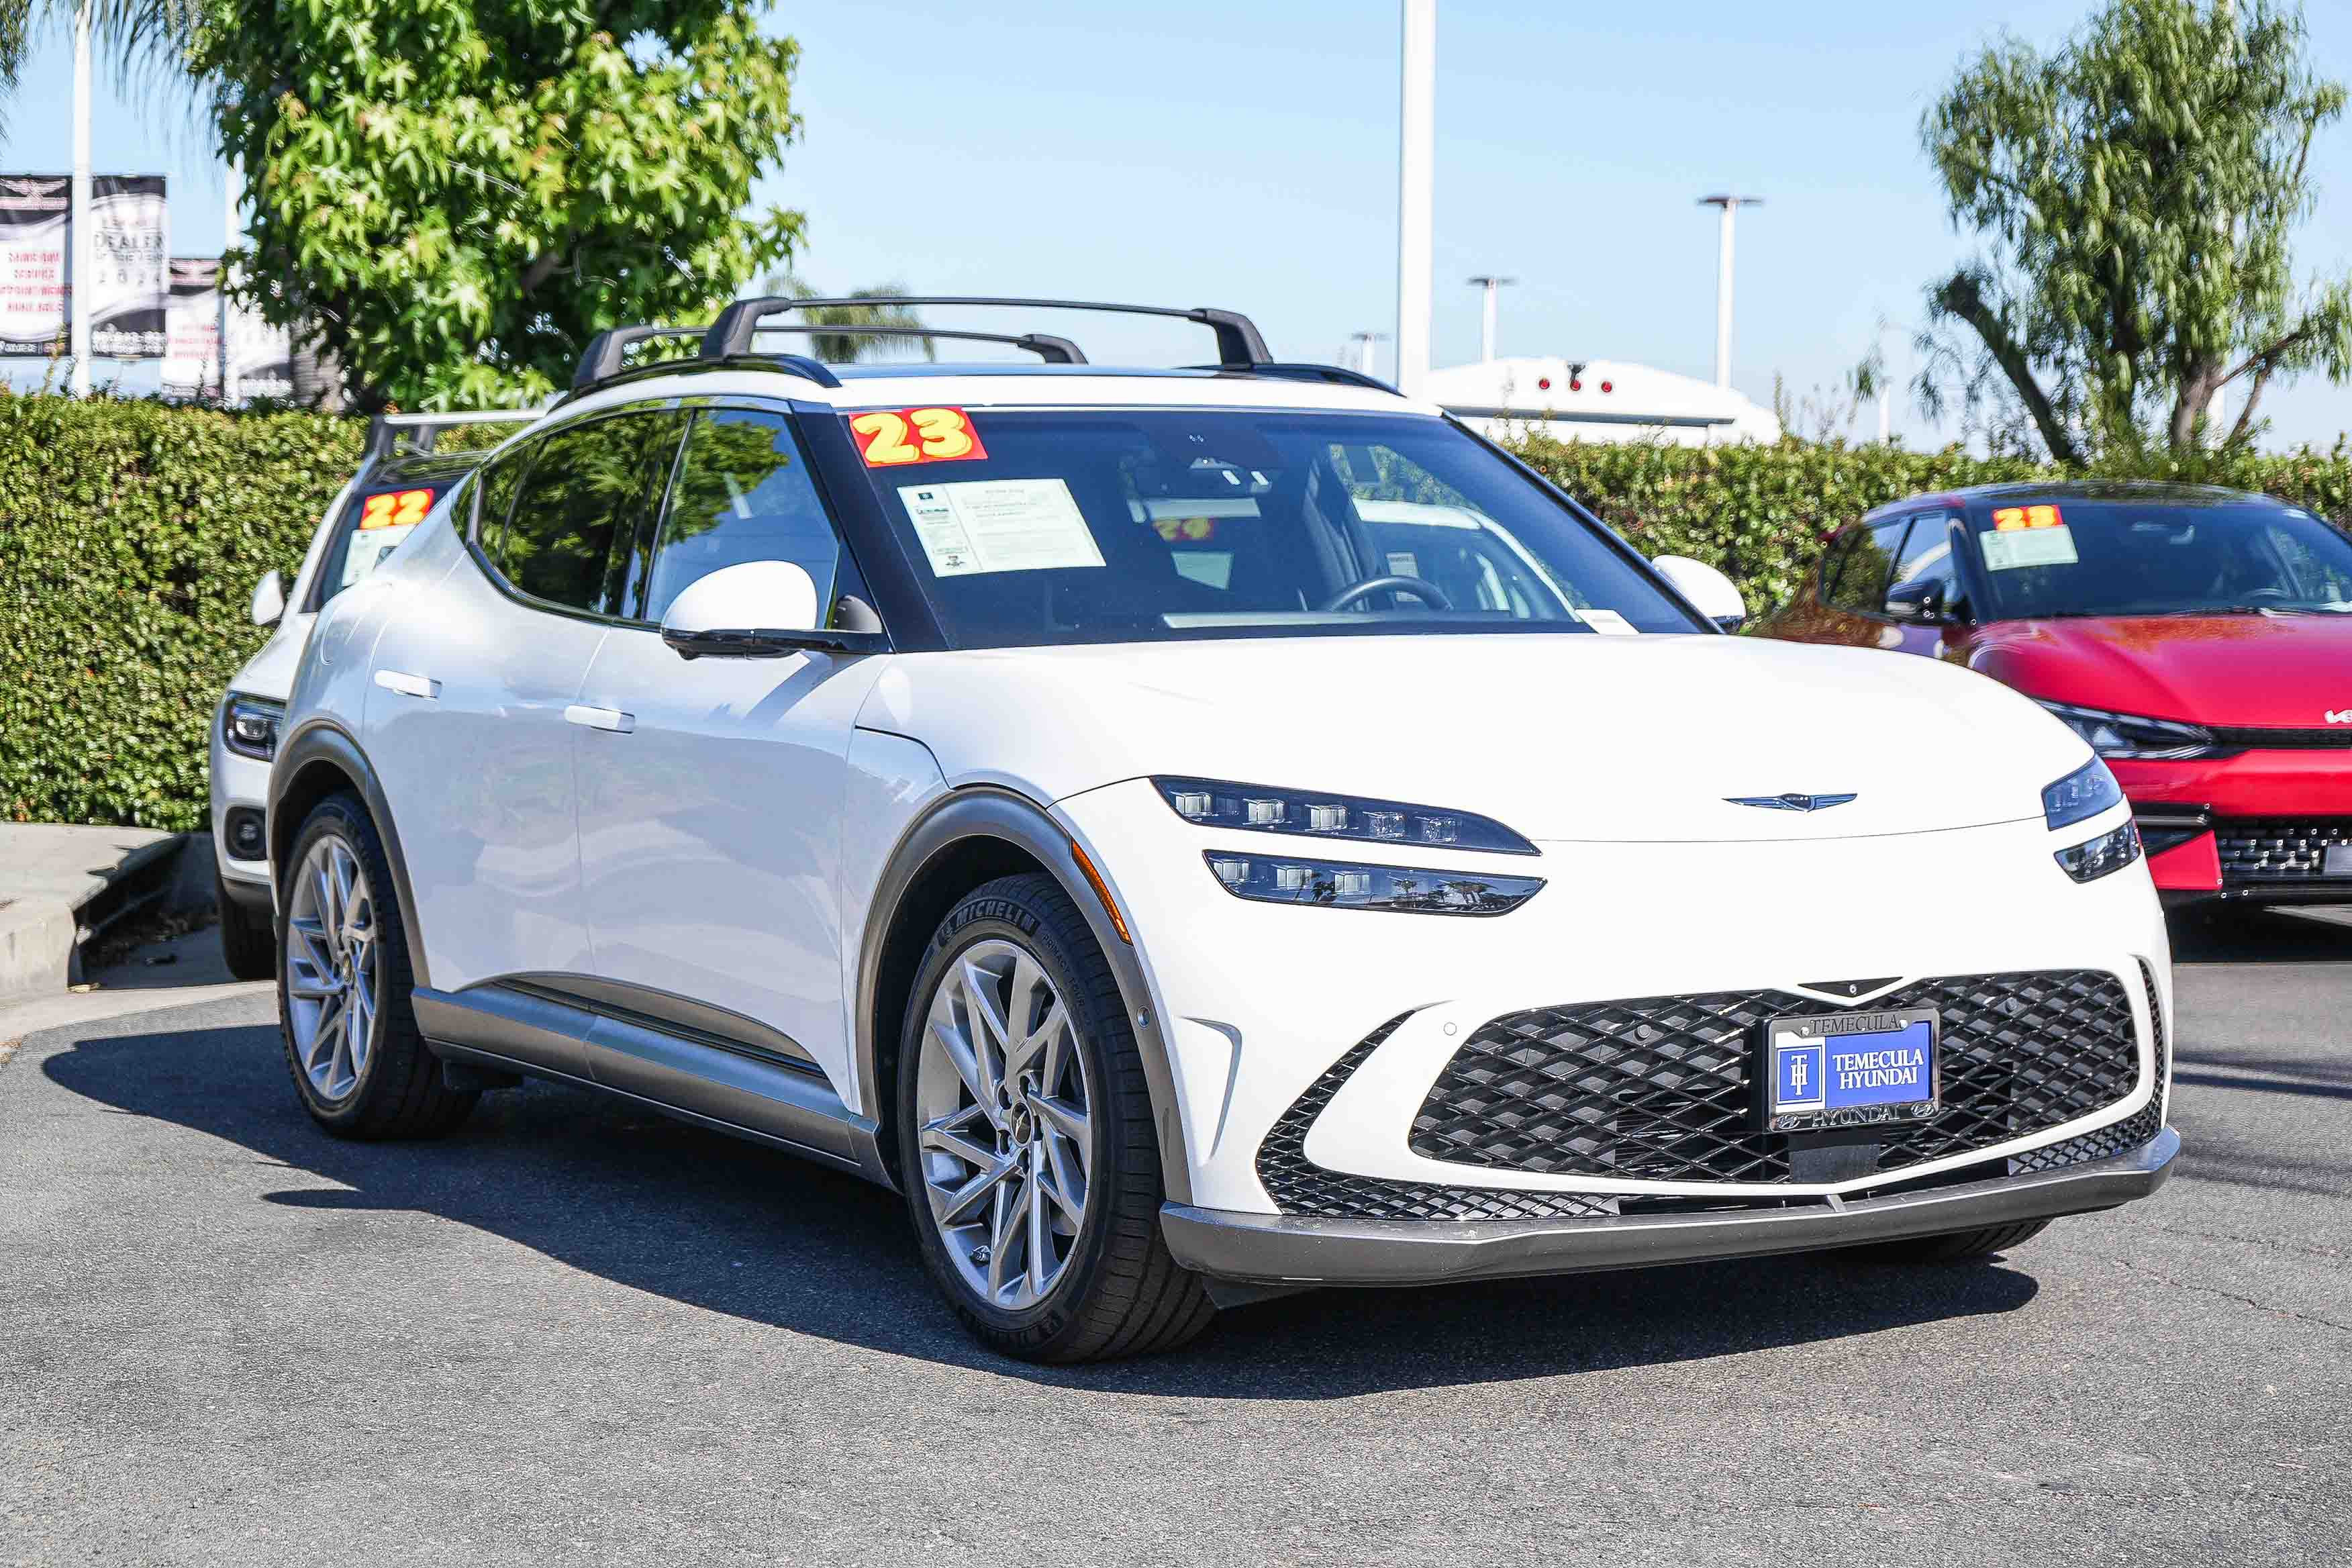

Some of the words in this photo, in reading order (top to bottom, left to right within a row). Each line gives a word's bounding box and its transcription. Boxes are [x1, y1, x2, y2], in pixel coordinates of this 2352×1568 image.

[852, 408, 973, 464] 23
[360, 490, 429, 529] 22
[956, 900, 1035, 931] MICHELIN
[1810, 1014, 1902, 1034] TEMECULA
[1832, 1048, 1924, 1072] TEMECULA
[1839, 1066, 1918, 1090] HYUNDAI
[1811, 1104, 1900, 1128] HYUNDAI
